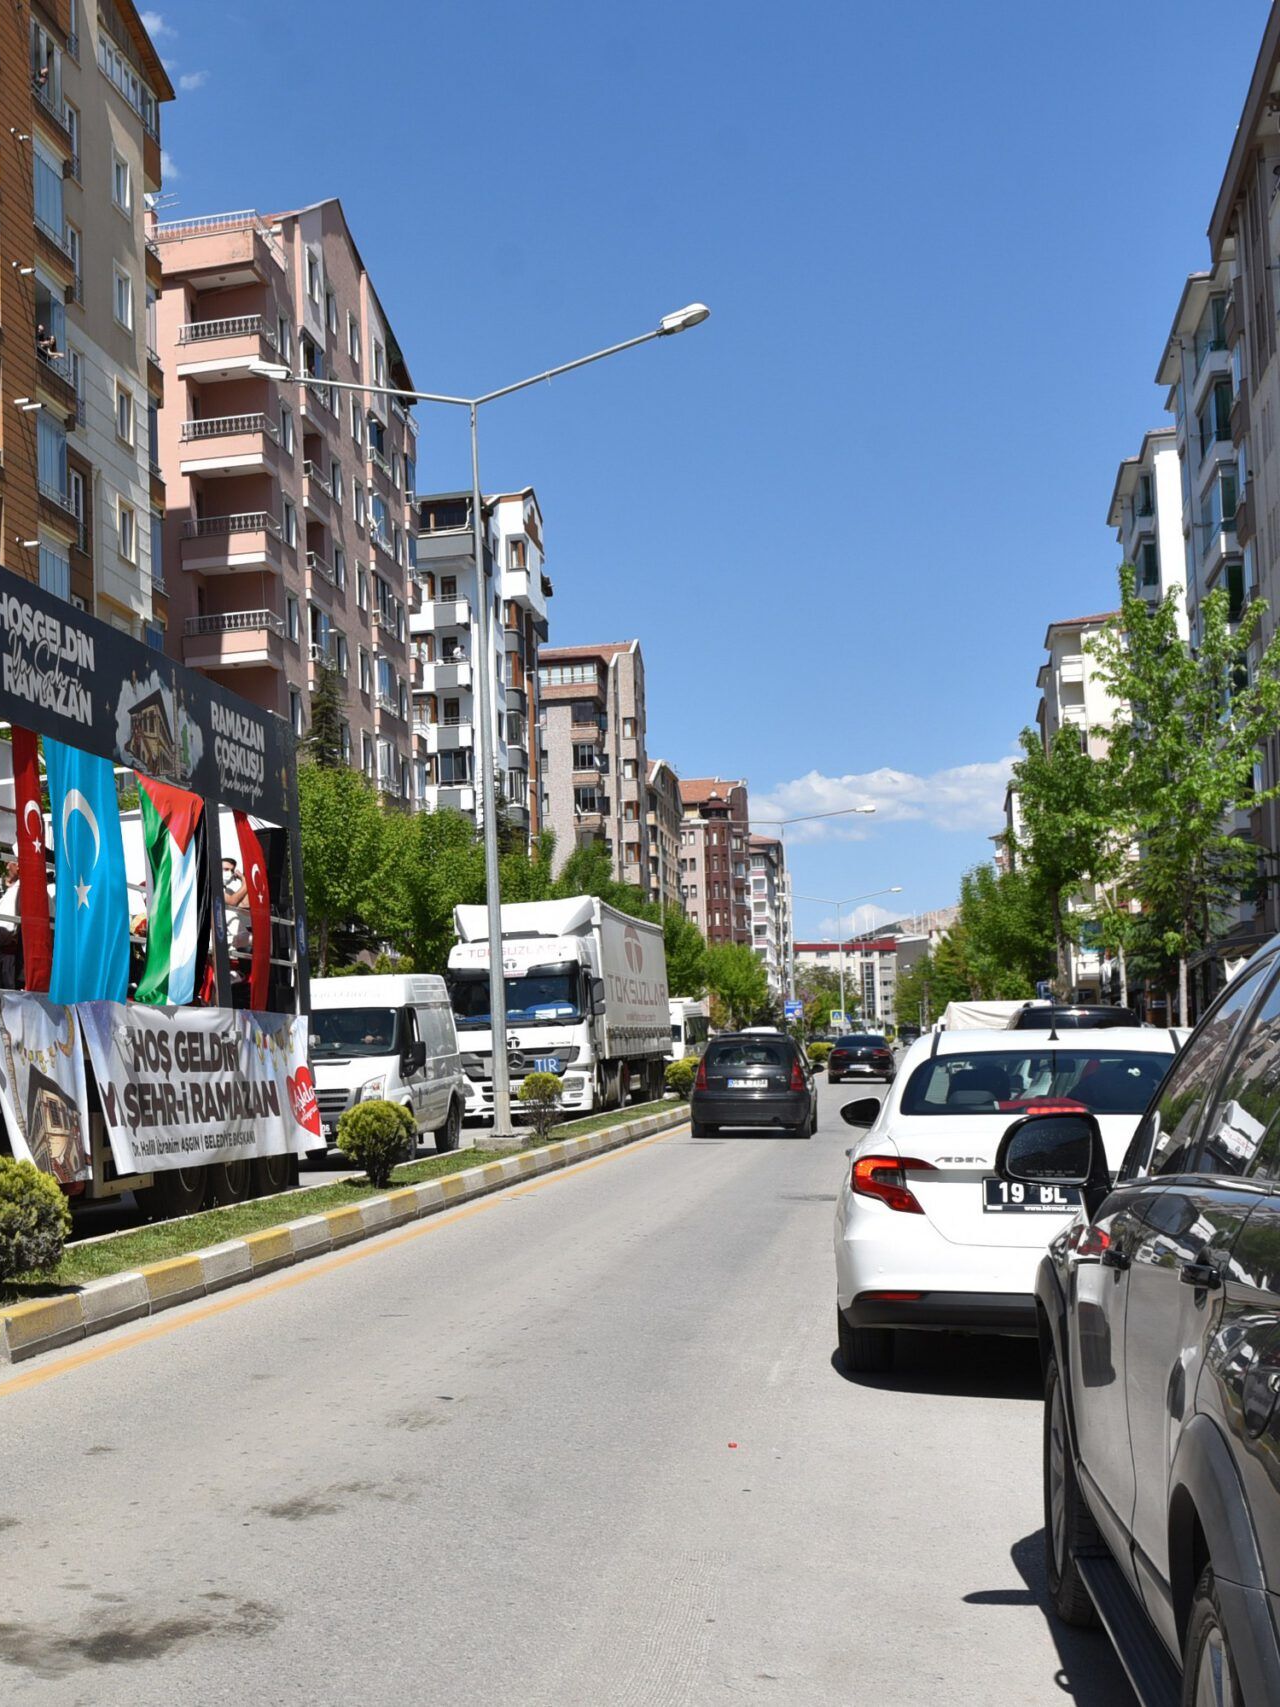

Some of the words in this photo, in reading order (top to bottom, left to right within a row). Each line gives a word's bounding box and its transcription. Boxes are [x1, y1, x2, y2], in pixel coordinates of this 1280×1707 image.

[2, 652, 93, 727] RAMAZAN
[210, 700, 265, 753] RAMAZAN
[214, 736, 265, 782] COŞKUSU
[131, 1029, 172, 1081] HOŞ
[174, 1029, 241, 1073] GELDİN
[535, 1059, 559, 1073] TIR
[189, 1080, 281, 1124] RAMAZAN
[999, 1181, 1025, 1203] 19
